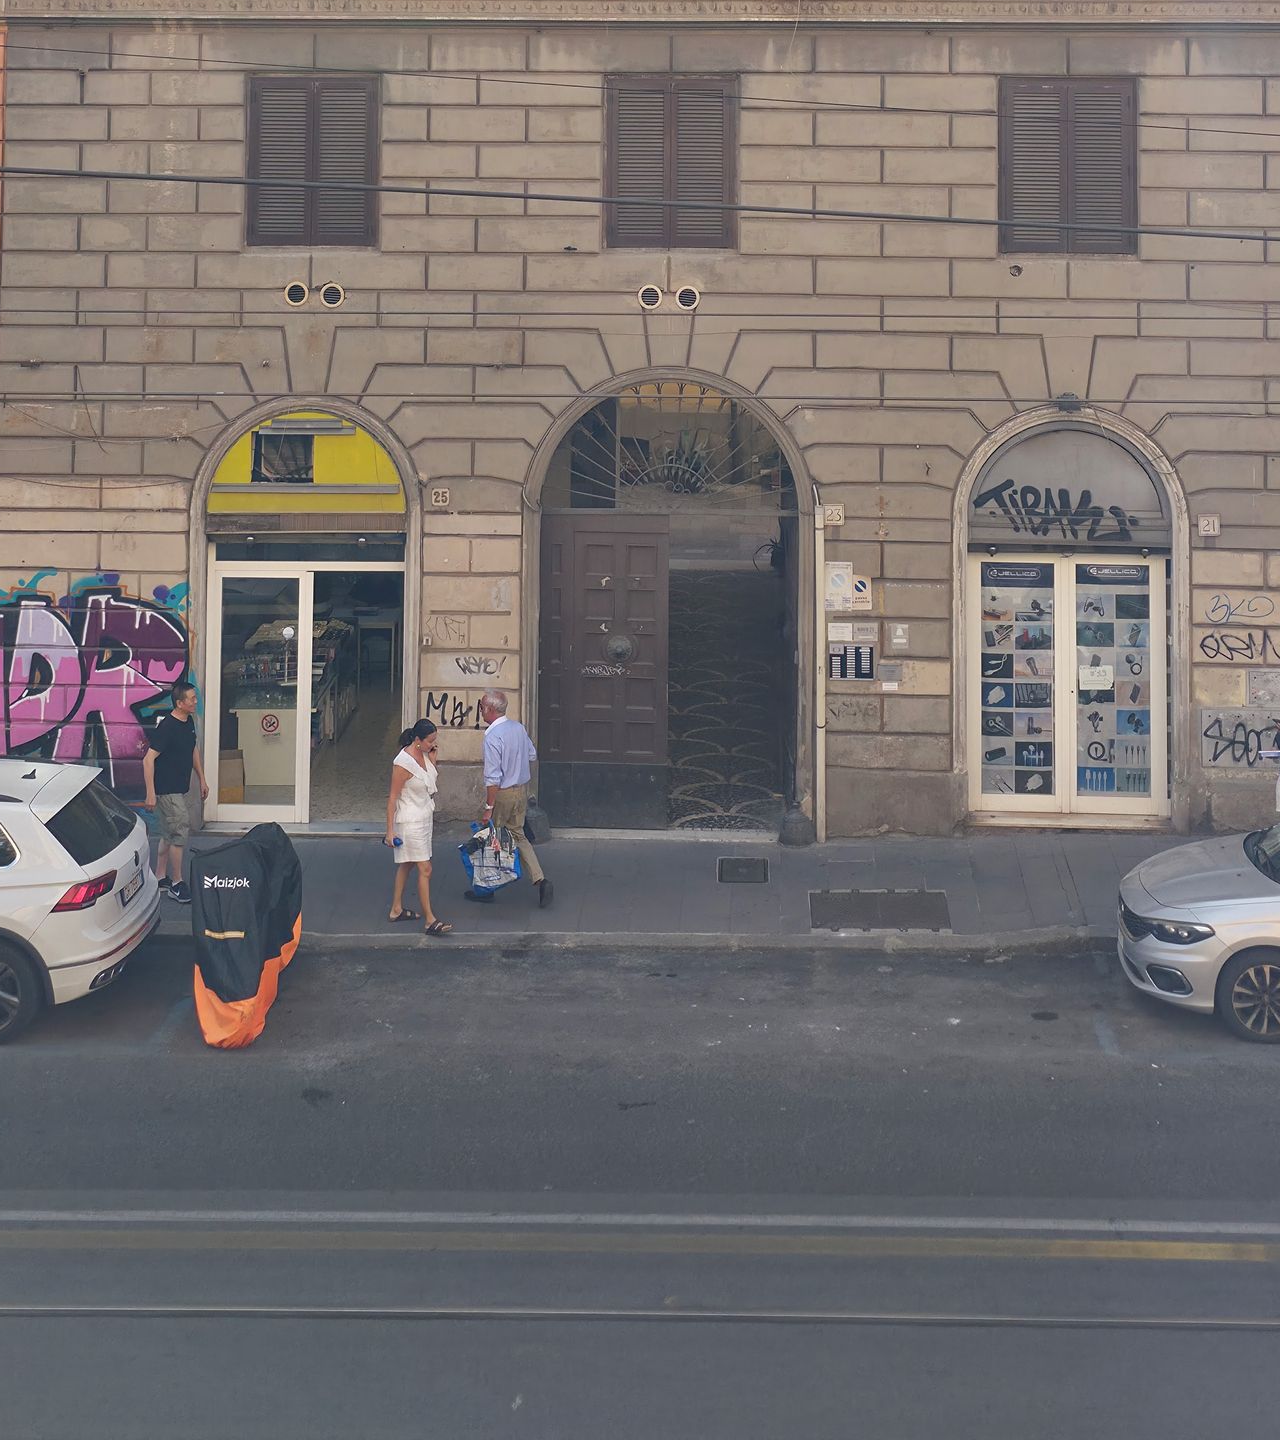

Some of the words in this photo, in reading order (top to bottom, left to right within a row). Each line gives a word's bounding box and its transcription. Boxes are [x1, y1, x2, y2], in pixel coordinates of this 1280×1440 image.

[433, 491, 448, 504] 25
[826, 509, 842, 522] 23
[1202, 519, 1216, 533] 21
[204, 875, 250, 890] Maizjok
